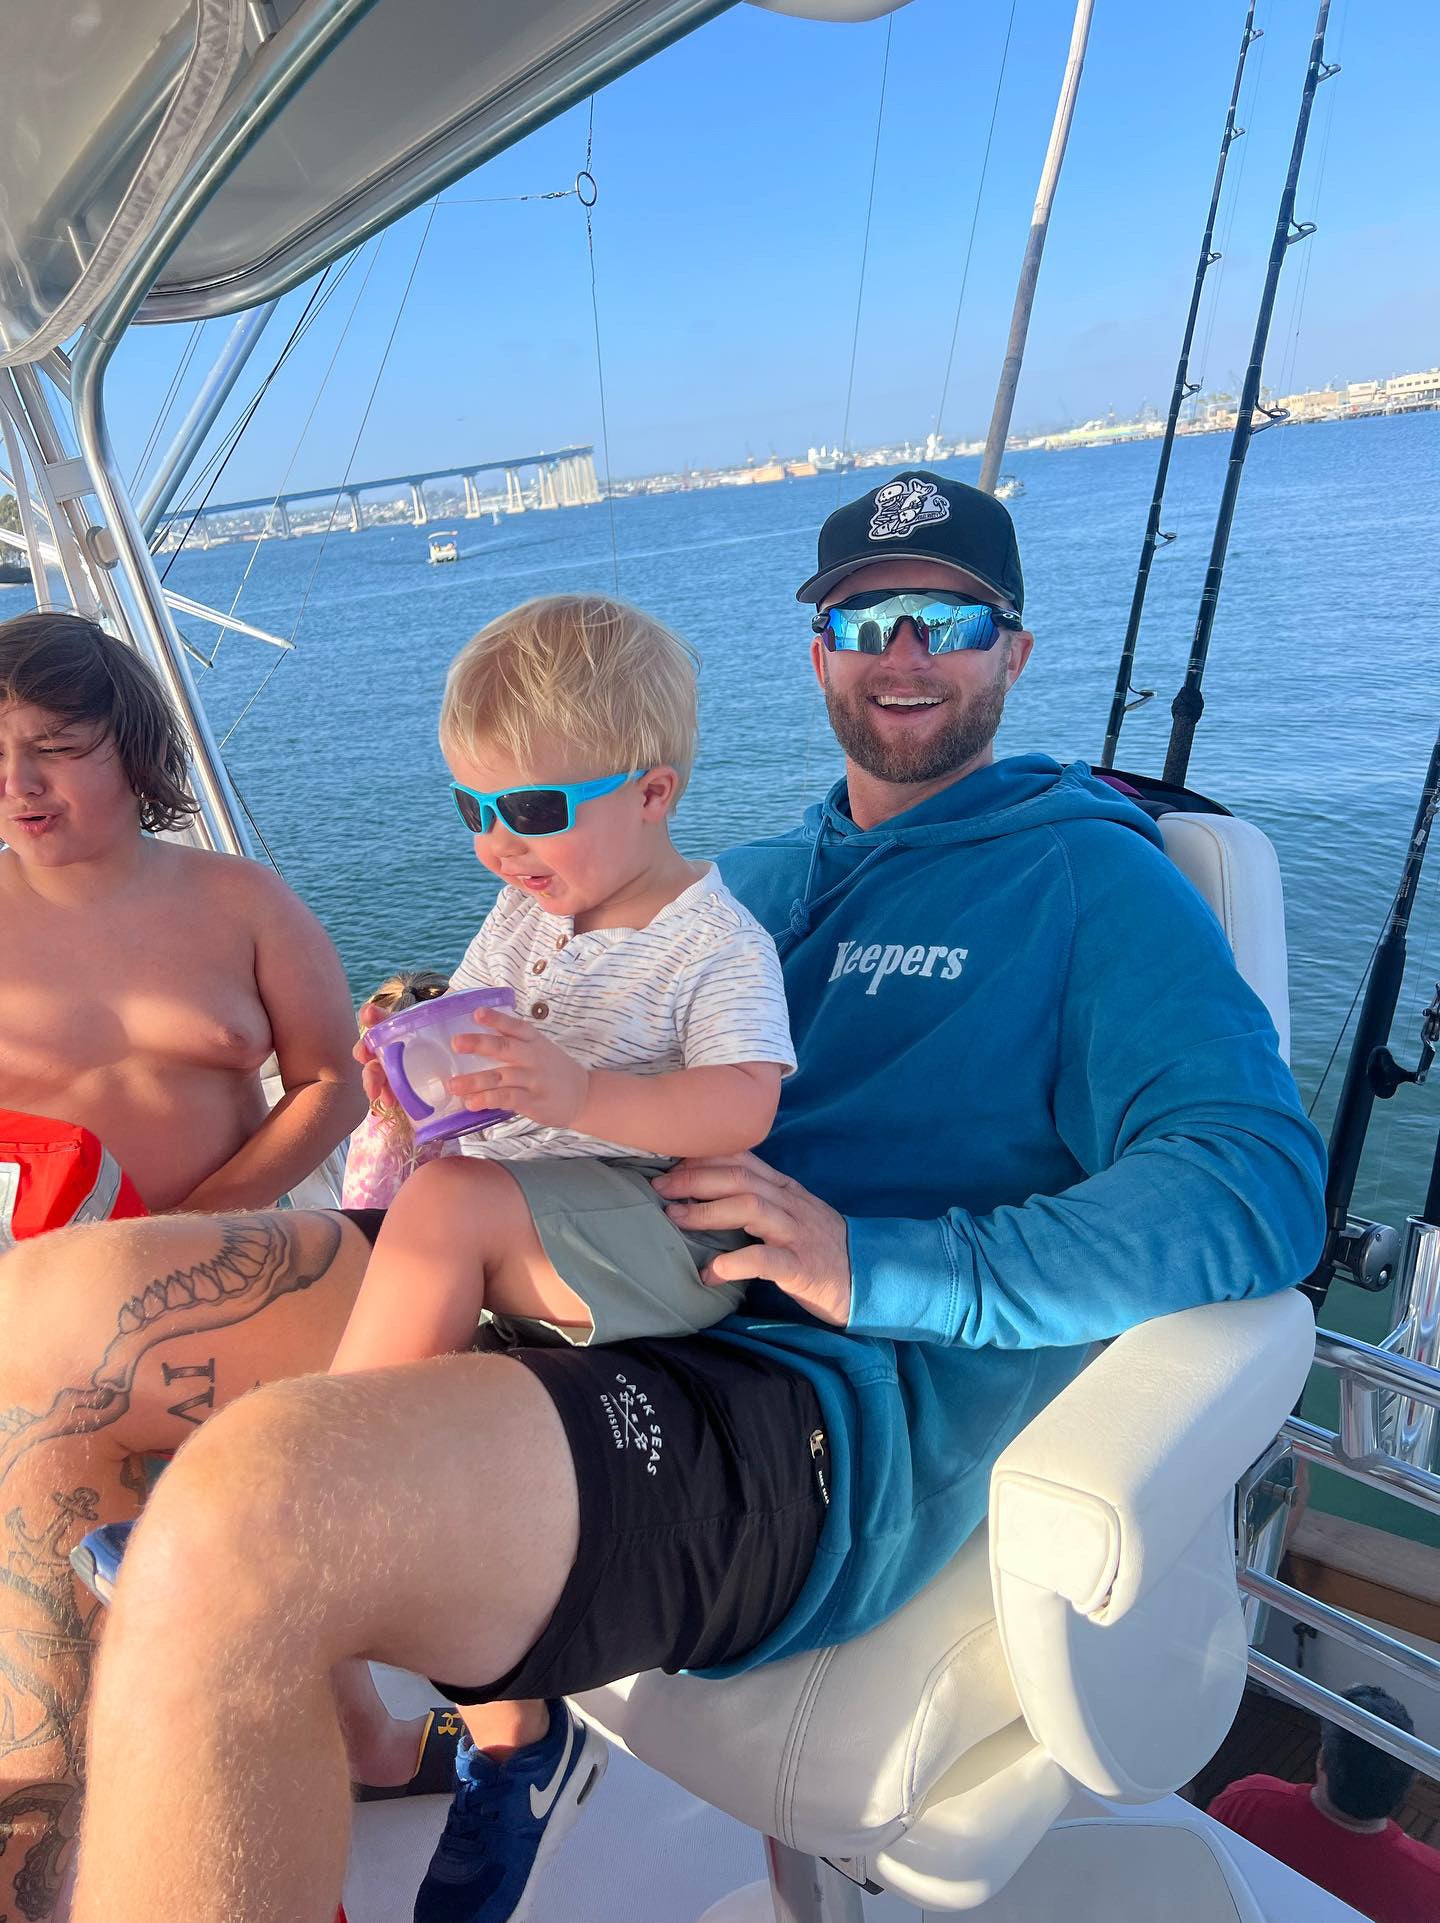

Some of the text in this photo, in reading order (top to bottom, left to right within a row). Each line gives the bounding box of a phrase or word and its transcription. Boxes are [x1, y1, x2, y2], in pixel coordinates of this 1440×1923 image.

[600, 1394, 624, 1449] DIVISION
[615, 1373, 663, 1475] DARK SEAS
